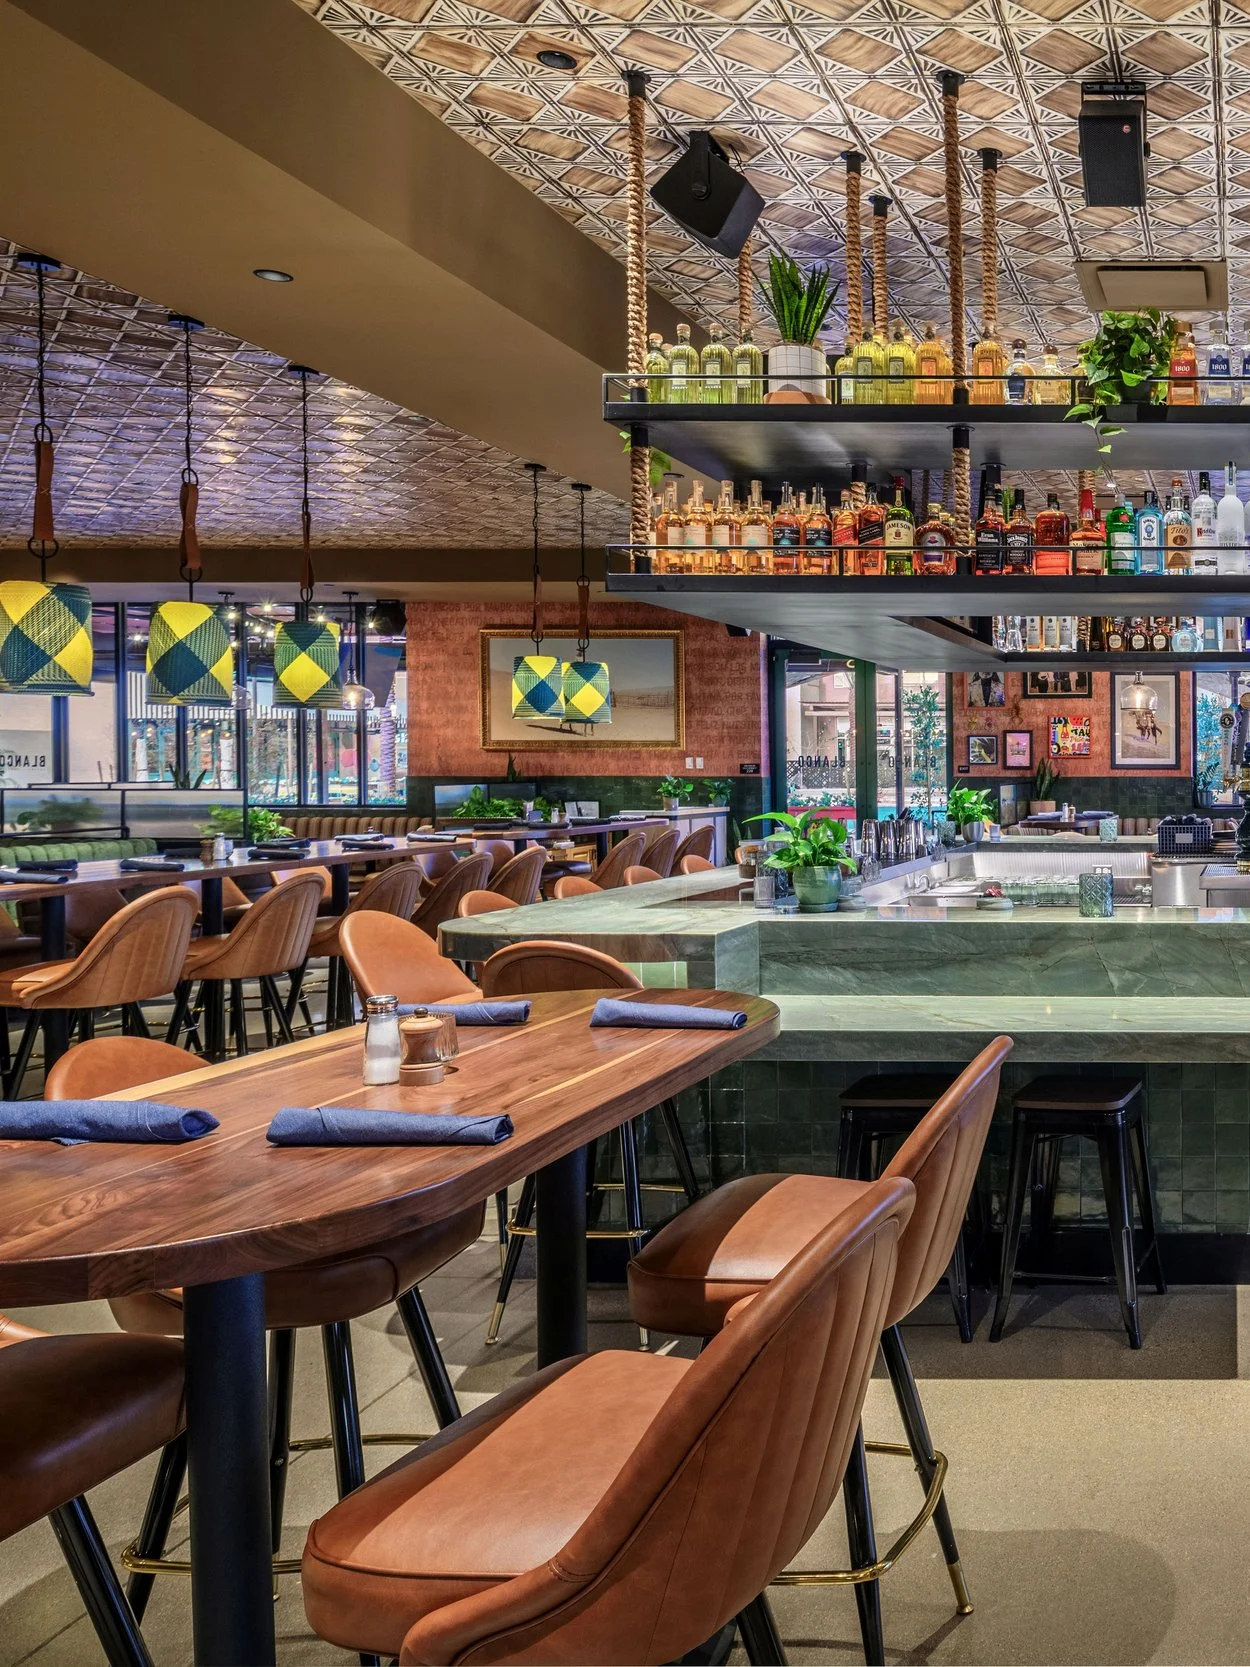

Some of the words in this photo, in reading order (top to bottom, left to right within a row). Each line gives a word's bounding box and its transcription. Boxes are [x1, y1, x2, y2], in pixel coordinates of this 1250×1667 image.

[1212, 363, 1227, 371] 1800
[886, 522, 911, 531] JAMESON
[1171, 526, 1189, 535] Tito's
